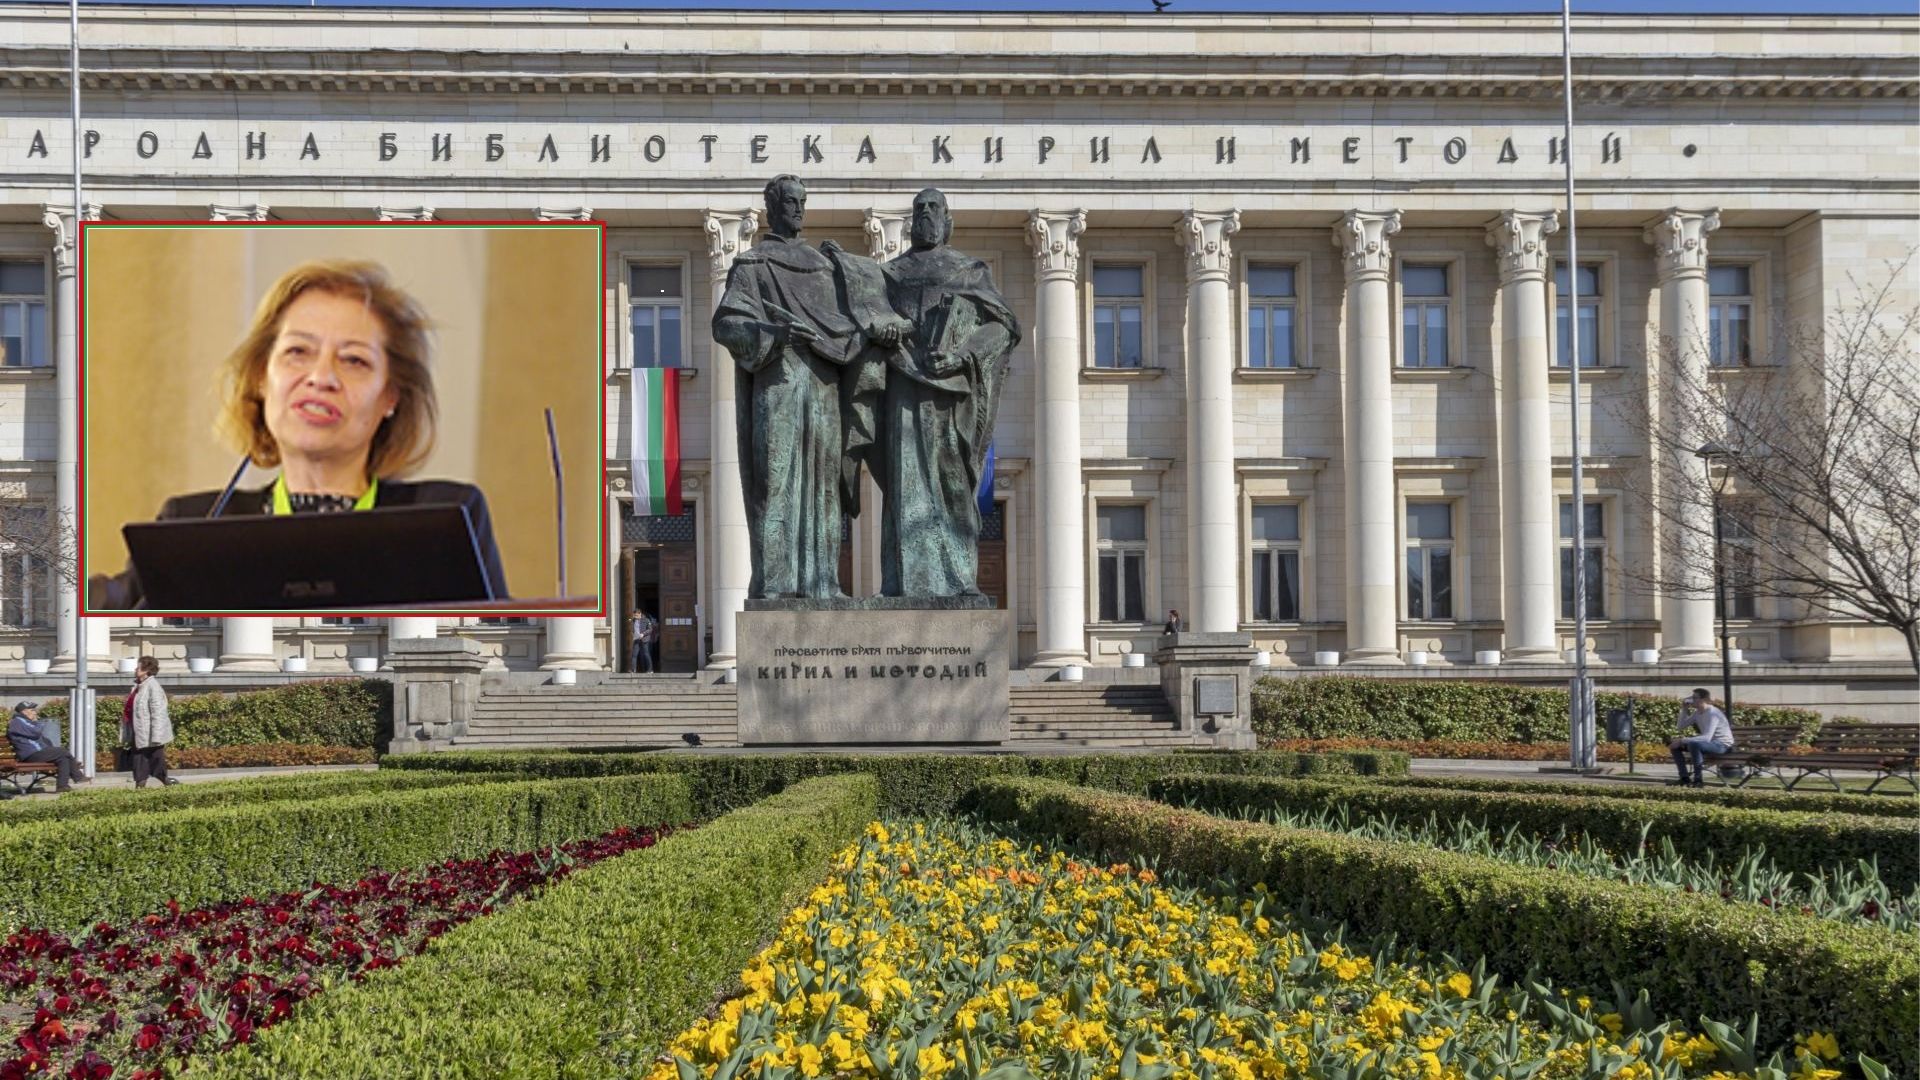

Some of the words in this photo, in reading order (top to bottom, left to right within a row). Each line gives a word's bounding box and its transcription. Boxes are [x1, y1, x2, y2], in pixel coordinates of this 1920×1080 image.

[379, 132, 877, 164] БИБЛИОТЕКА
[931, 135, 1162, 164] КИРИЛ
[1215, 136, 1236, 164] И
[1290, 132, 1622, 164] МЕТОДИЙ
[757, 661, 833, 680] КИРИЛ
[845, 664, 858, 679] И
[871, 660, 988, 681] МЕТОДИЙ
